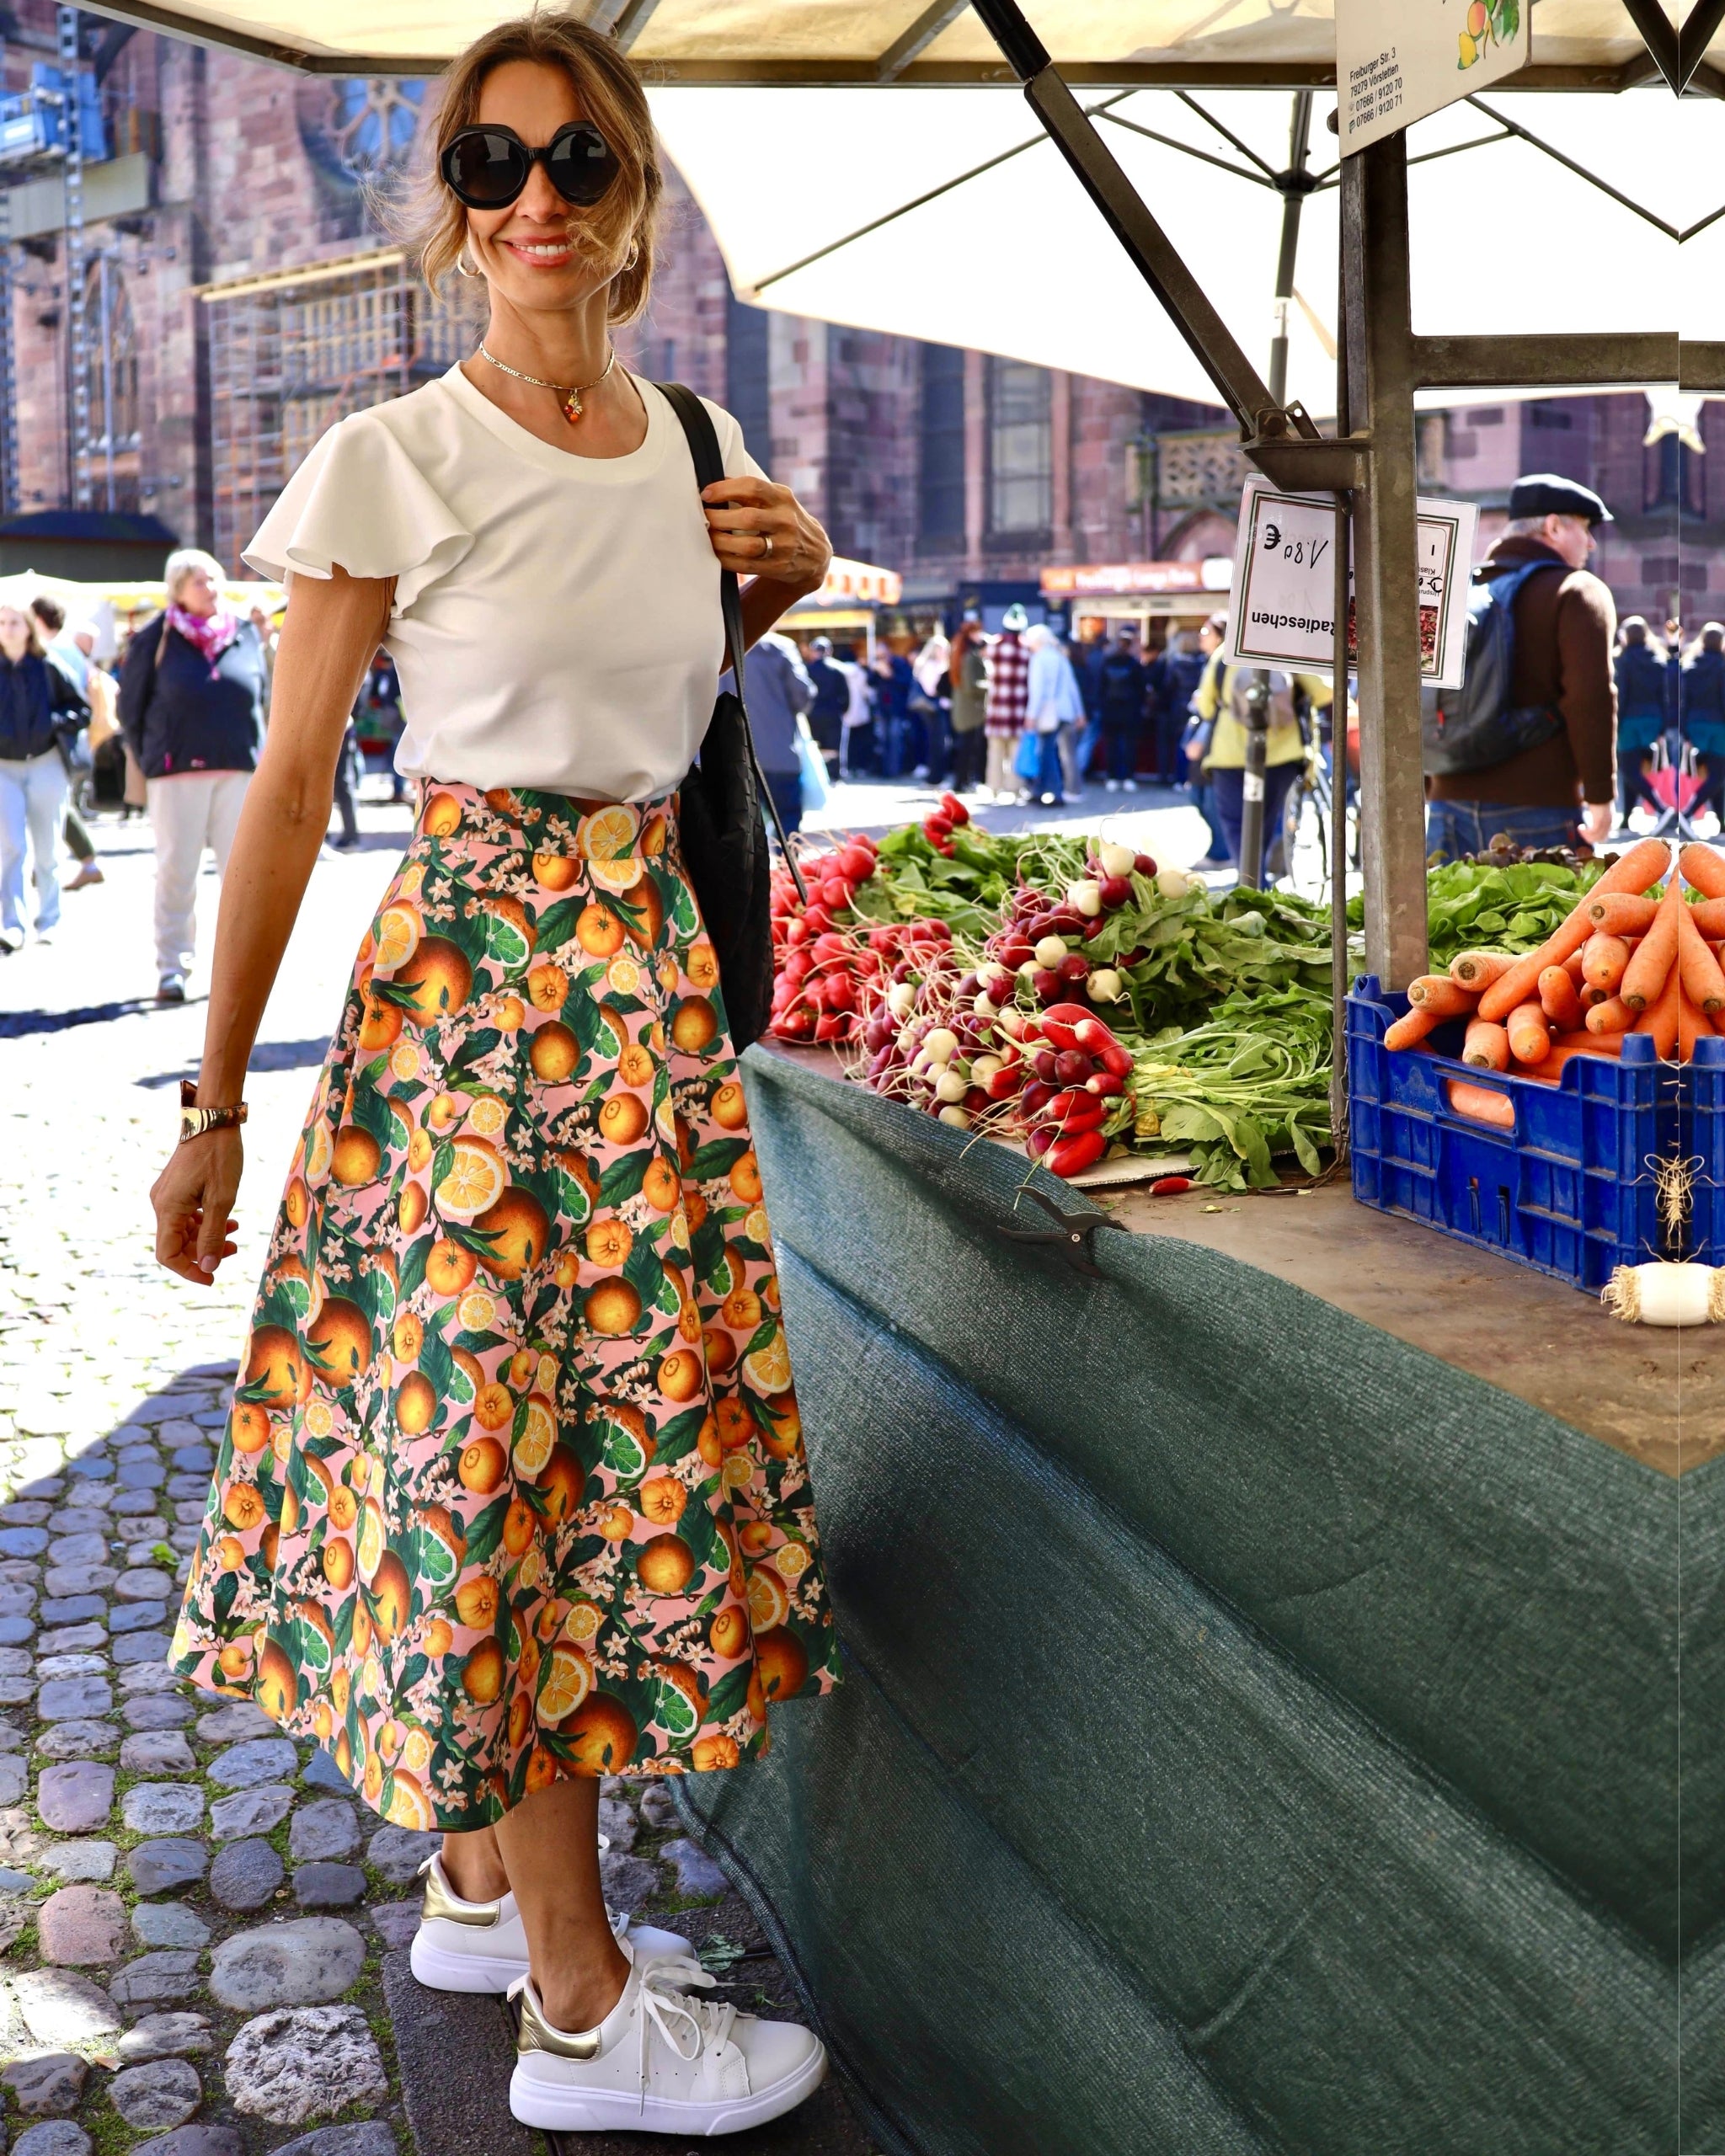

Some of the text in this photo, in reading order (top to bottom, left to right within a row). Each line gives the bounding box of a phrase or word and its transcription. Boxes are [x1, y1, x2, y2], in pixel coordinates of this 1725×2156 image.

[1350, 47, 1396, 83] Freiburger Str. 3
[1350, 64, 1399, 98] 79279 Vörstetten
[1355, 93, 1374, 112] 07666
[1378, 82, 1393, 99] 9120
[1394, 77, 1402, 91] 70
[1356, 109, 1374, 127] 07666
[1379, 98, 1394, 115] 9120
[1395, 93, 1402, 107] 71
[1263, 524, 1282, 550] €
